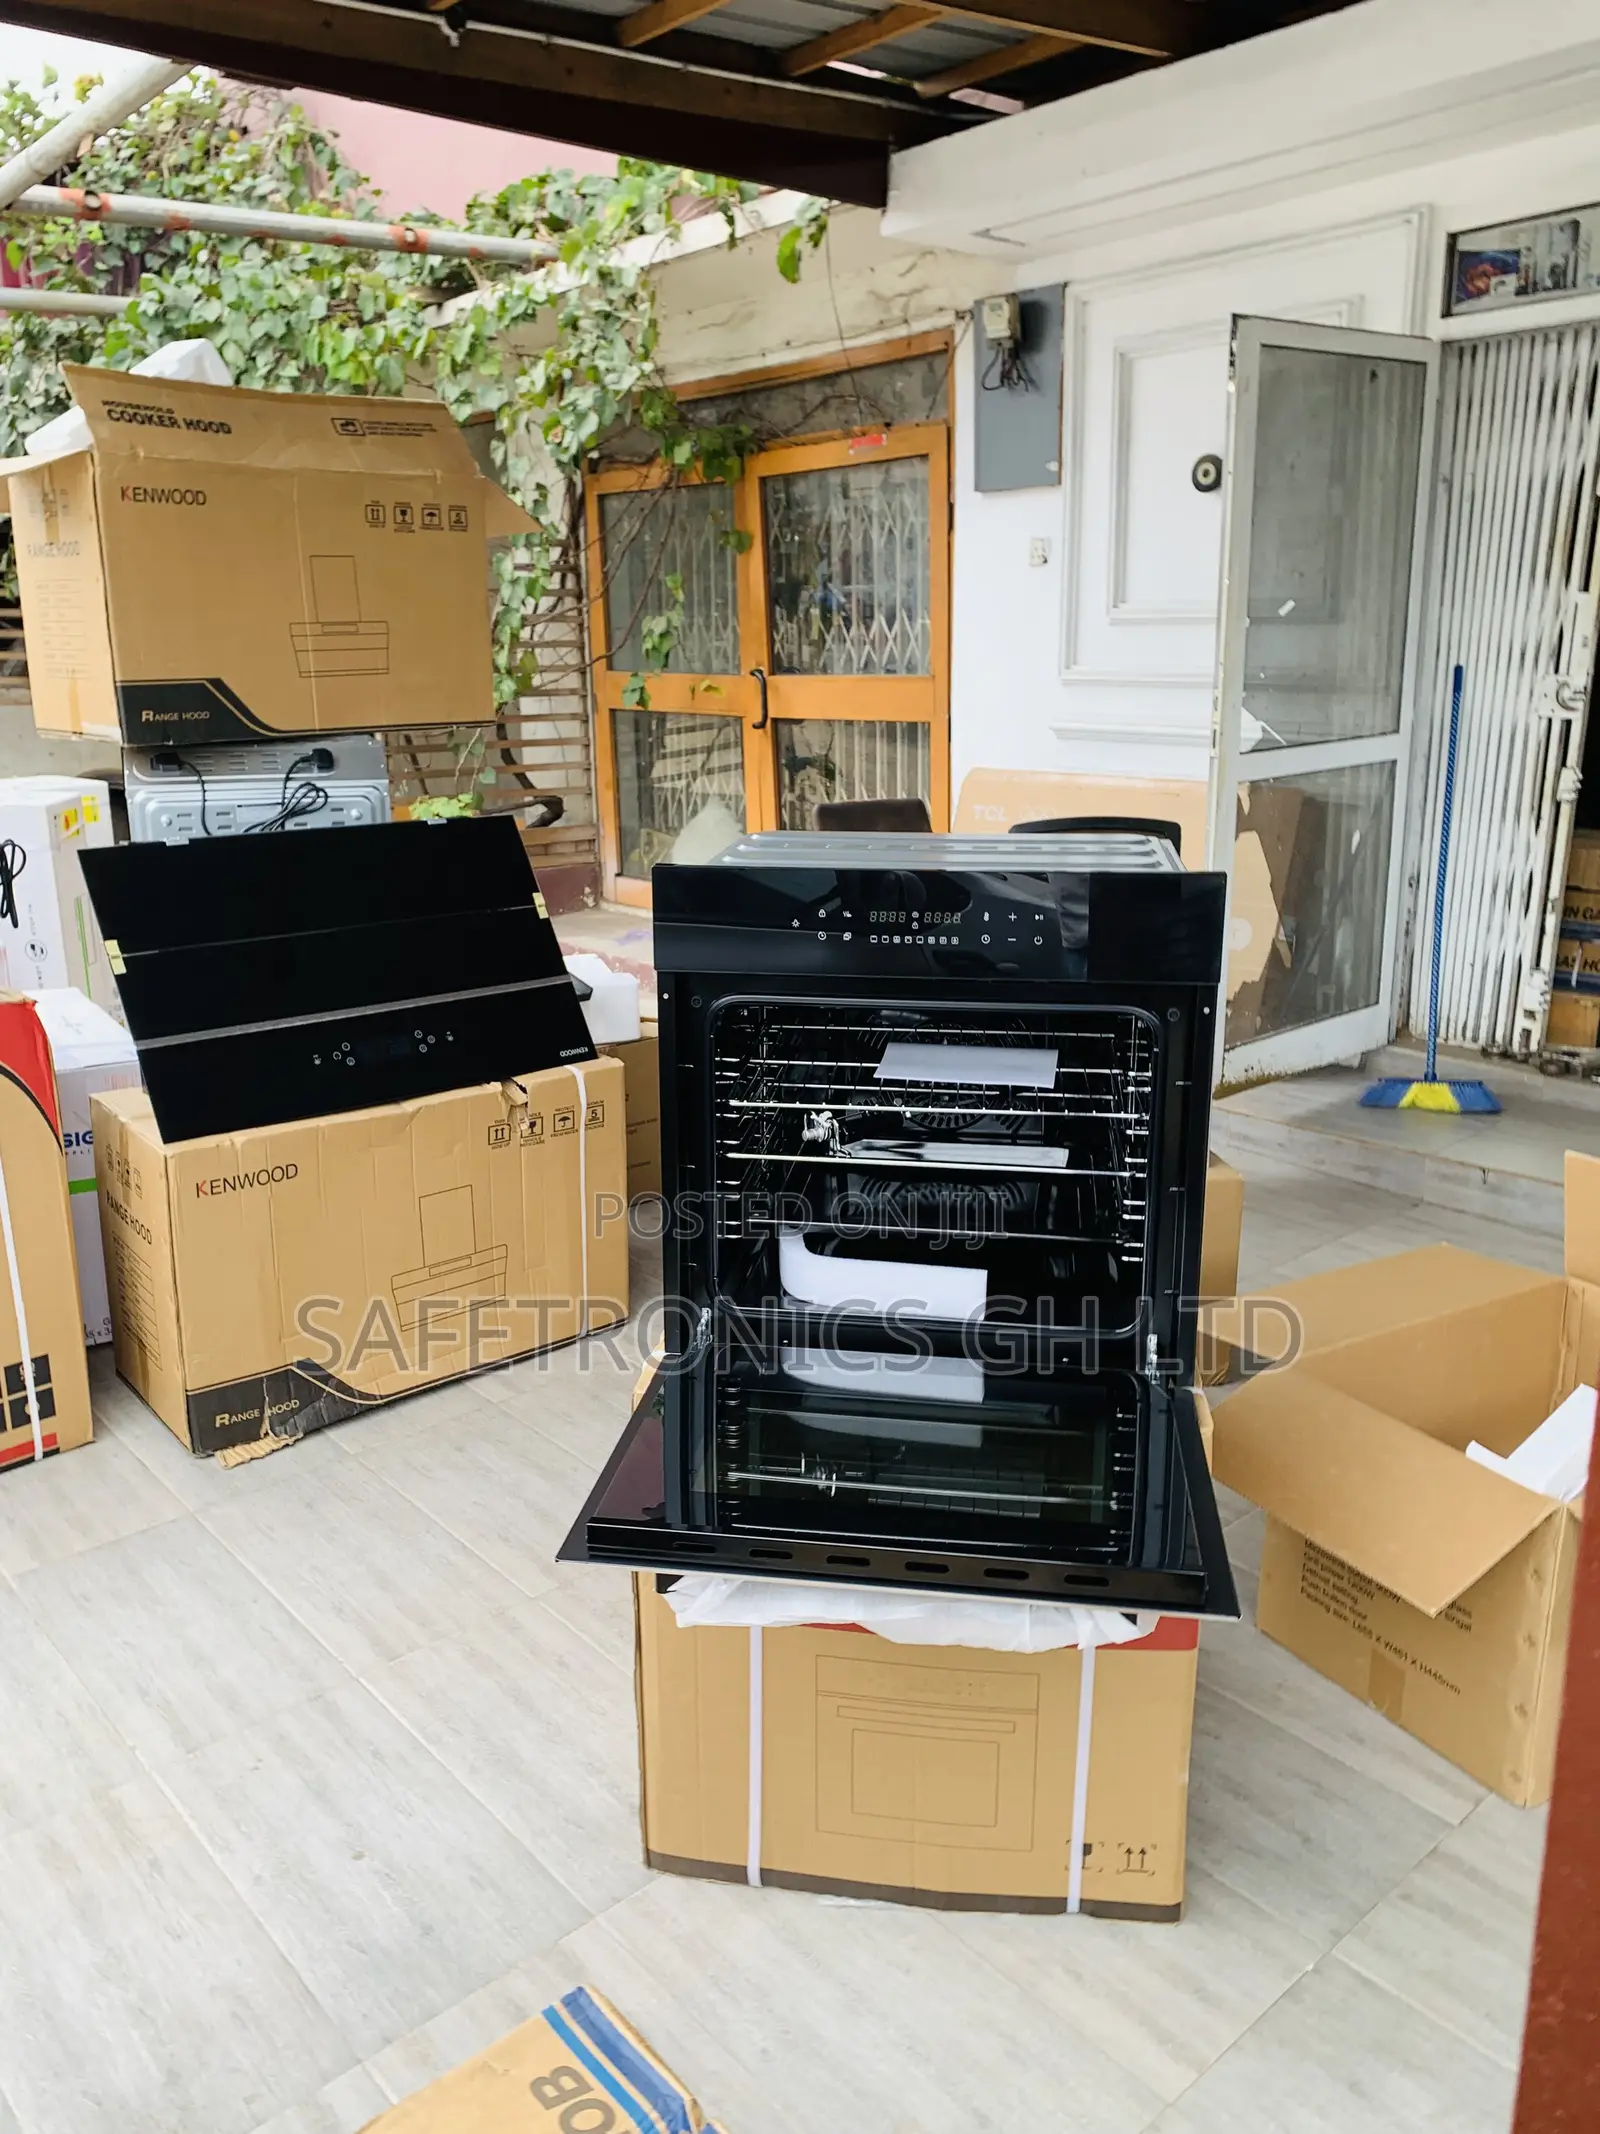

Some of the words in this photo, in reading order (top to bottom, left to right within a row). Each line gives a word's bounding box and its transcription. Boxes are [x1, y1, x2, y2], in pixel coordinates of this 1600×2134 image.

[106, 408, 182, 429] COOKER
[182, 418, 233, 435] HOOD
[120, 486, 208, 506] KENWOOD
[196, 1163, 299, 1199] KENWOOD
[106, 1189, 130, 1227] RANGE
[130, 1213, 152, 1246] HOOD
[267, 1399, 300, 1417] HOOD
